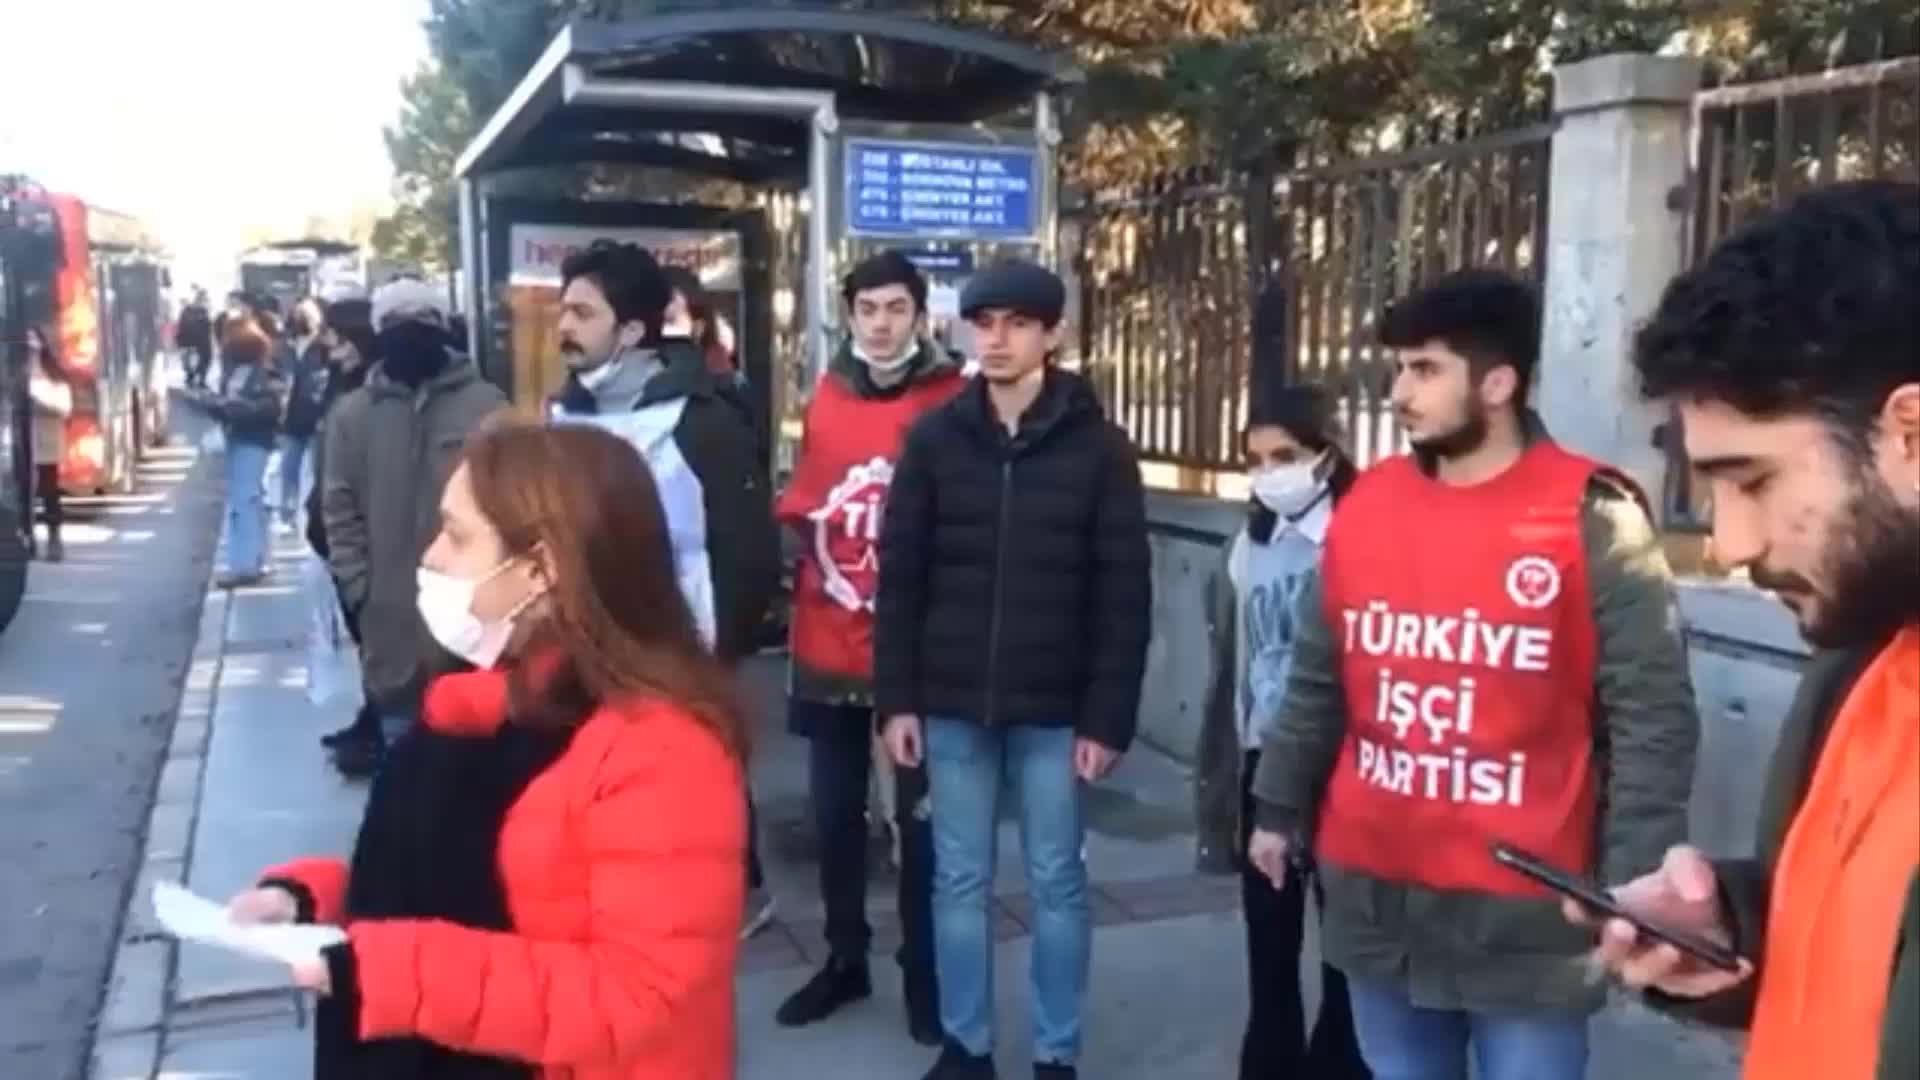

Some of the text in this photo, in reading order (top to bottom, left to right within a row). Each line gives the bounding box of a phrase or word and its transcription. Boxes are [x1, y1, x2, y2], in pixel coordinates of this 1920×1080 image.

[1342, 600, 1552, 671] TÜRKİYE
[1375, 668, 1477, 745] İŞÇİ
[1358, 738, 1527, 807] PARTİSİ
